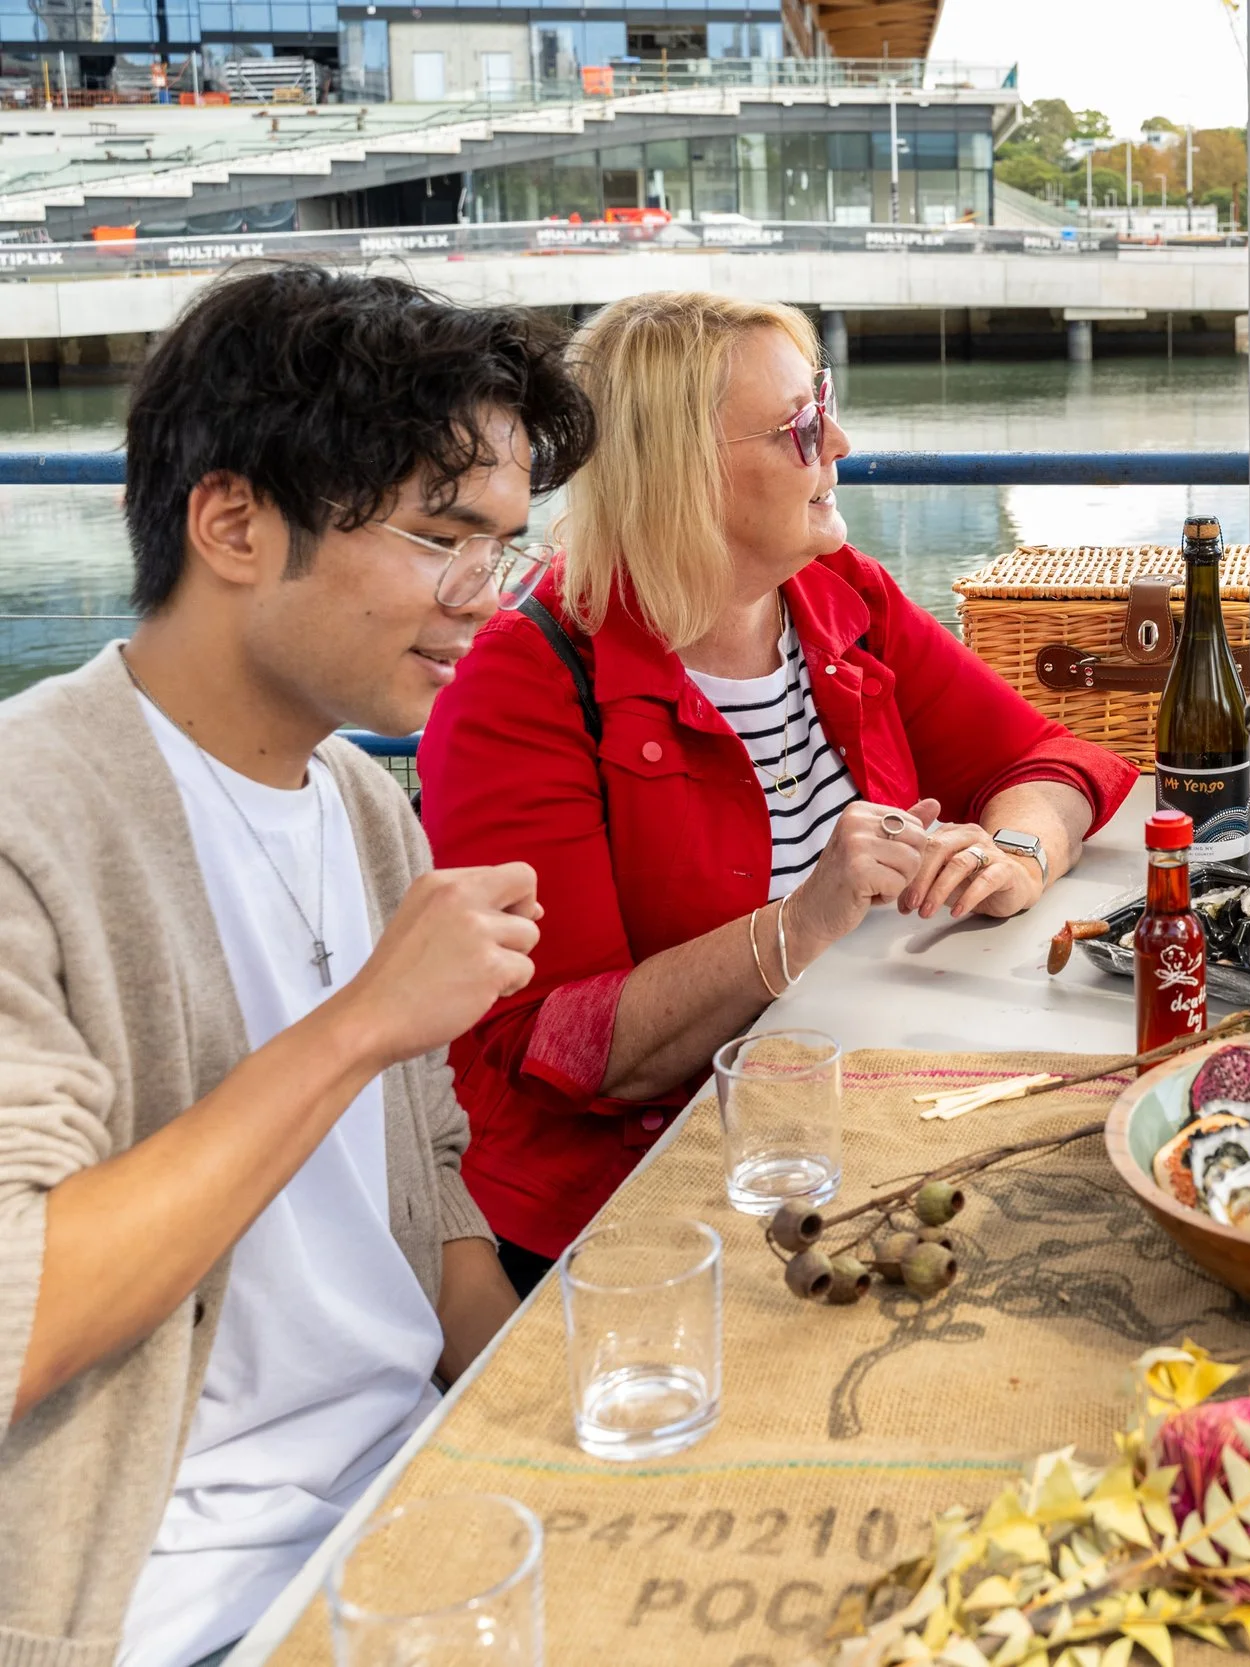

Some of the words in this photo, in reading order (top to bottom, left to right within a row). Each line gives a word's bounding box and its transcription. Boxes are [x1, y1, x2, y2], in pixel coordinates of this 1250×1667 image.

[167, 242, 265, 261] MULTIPLEX
[360, 234, 449, 251] MULTIPLEX
[1163, 777, 1180, 790] Mt
[1183, 778, 1225, 794] Yengo
[1187, 1009, 1203, 1034] by
